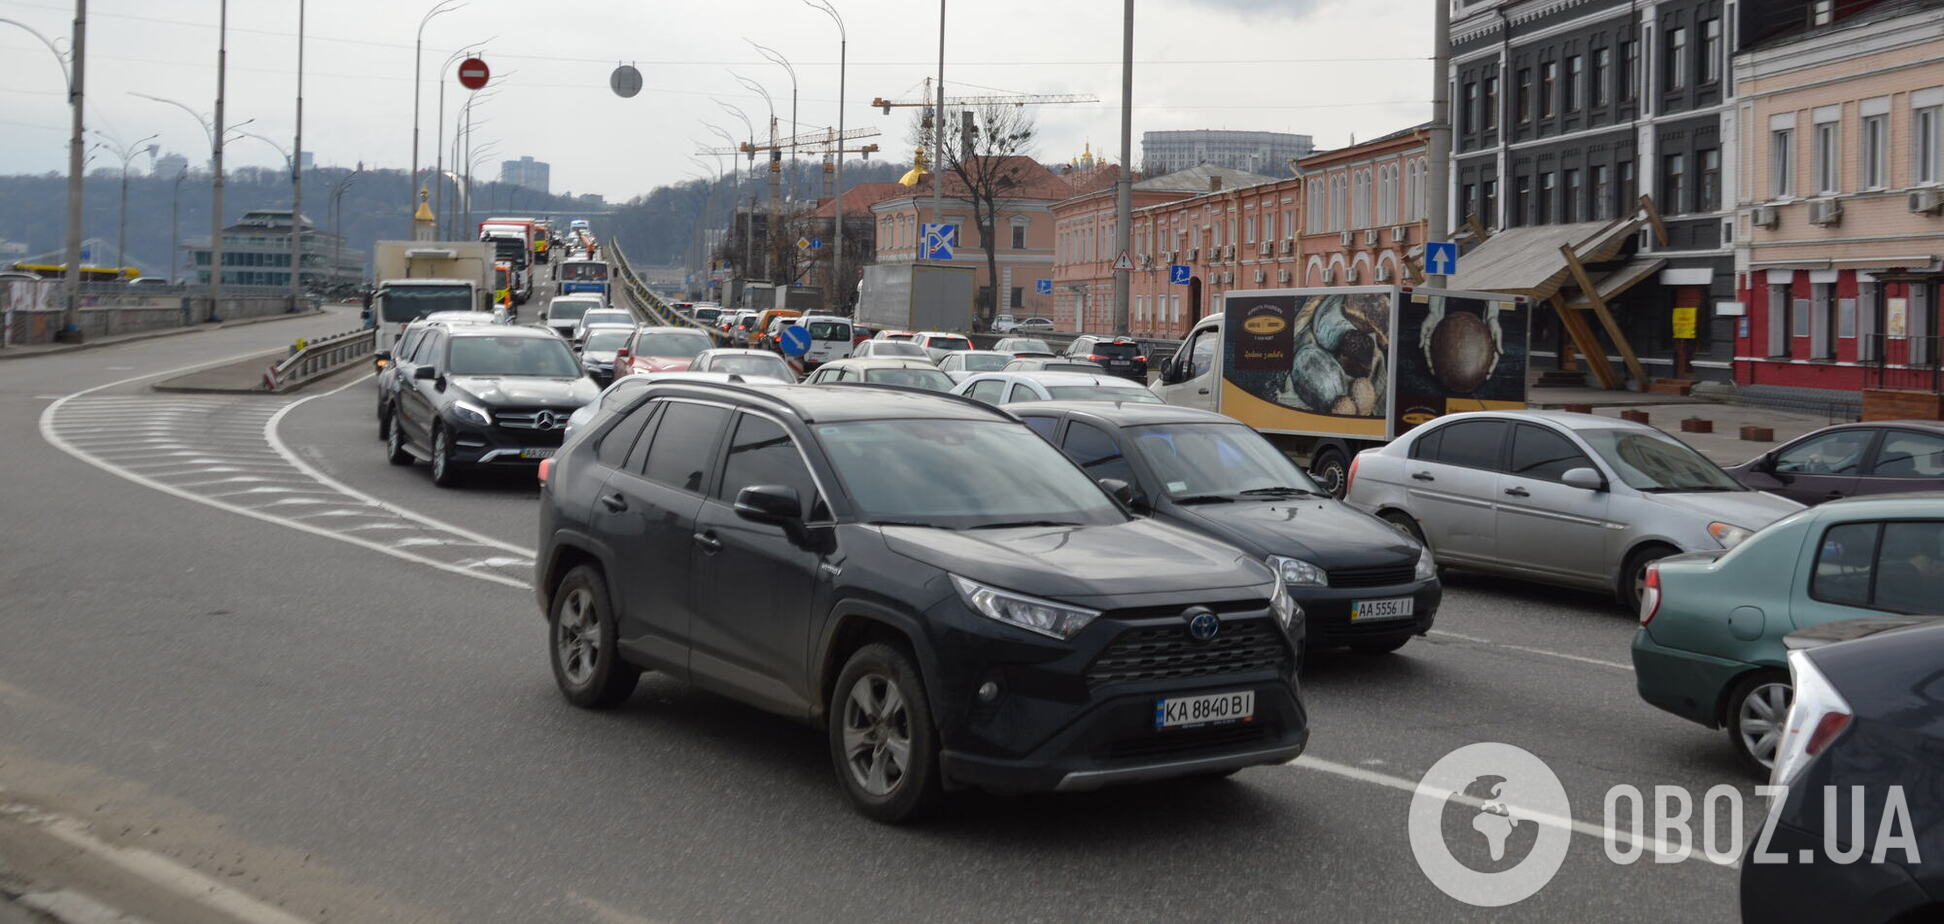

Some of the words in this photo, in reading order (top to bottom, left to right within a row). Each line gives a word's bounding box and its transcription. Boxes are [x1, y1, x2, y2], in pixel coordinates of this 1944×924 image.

[1360, 603, 1373, 617] AA
[1375, 601, 1397, 616] 5556
[1165, 701, 1188, 722] KA
[1192, 697, 1228, 719] 8840
